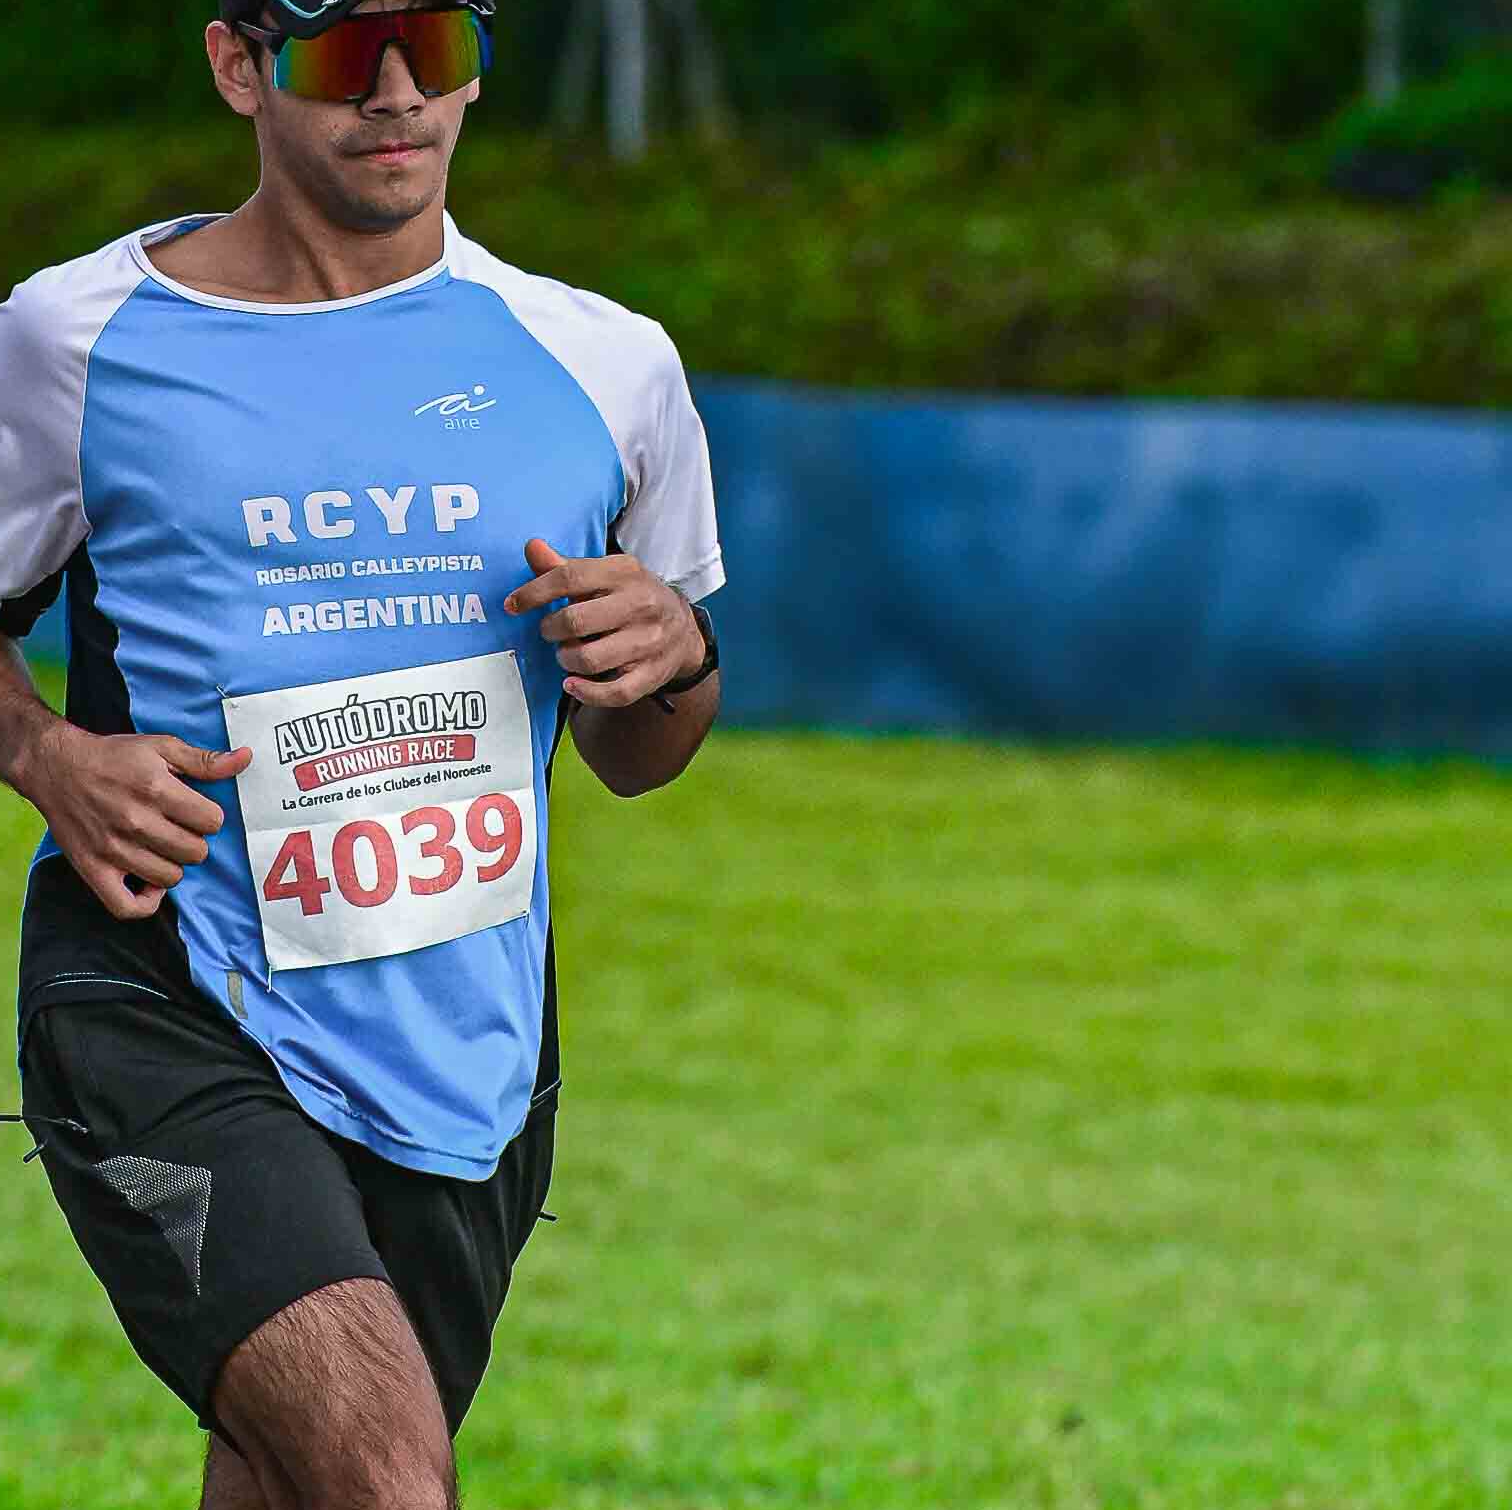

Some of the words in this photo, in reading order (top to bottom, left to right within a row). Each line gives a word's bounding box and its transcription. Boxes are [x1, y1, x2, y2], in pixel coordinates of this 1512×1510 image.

[444, 417, 481, 430] aire
[256, 561, 345, 586] ROSARIO
[351, 555, 484, 577] CALLEYPISTA
[262, 593, 487, 637] ARGENTINA
[274, 691, 487, 764] AUTÓDROMO
[314, 746, 402, 784] RUNNING
[407, 739, 455, 763] RACE
[282, 798, 297, 811] La
[298, 791, 344, 808] Carrera
[346, 786, 361, 799] de
[364, 783, 382, 796] los
[383, 777, 422, 794] Clubes
[423, 771, 441, 785] del
[443, 763, 492, 782] Noroeste
[262, 792, 524, 917] 4039
